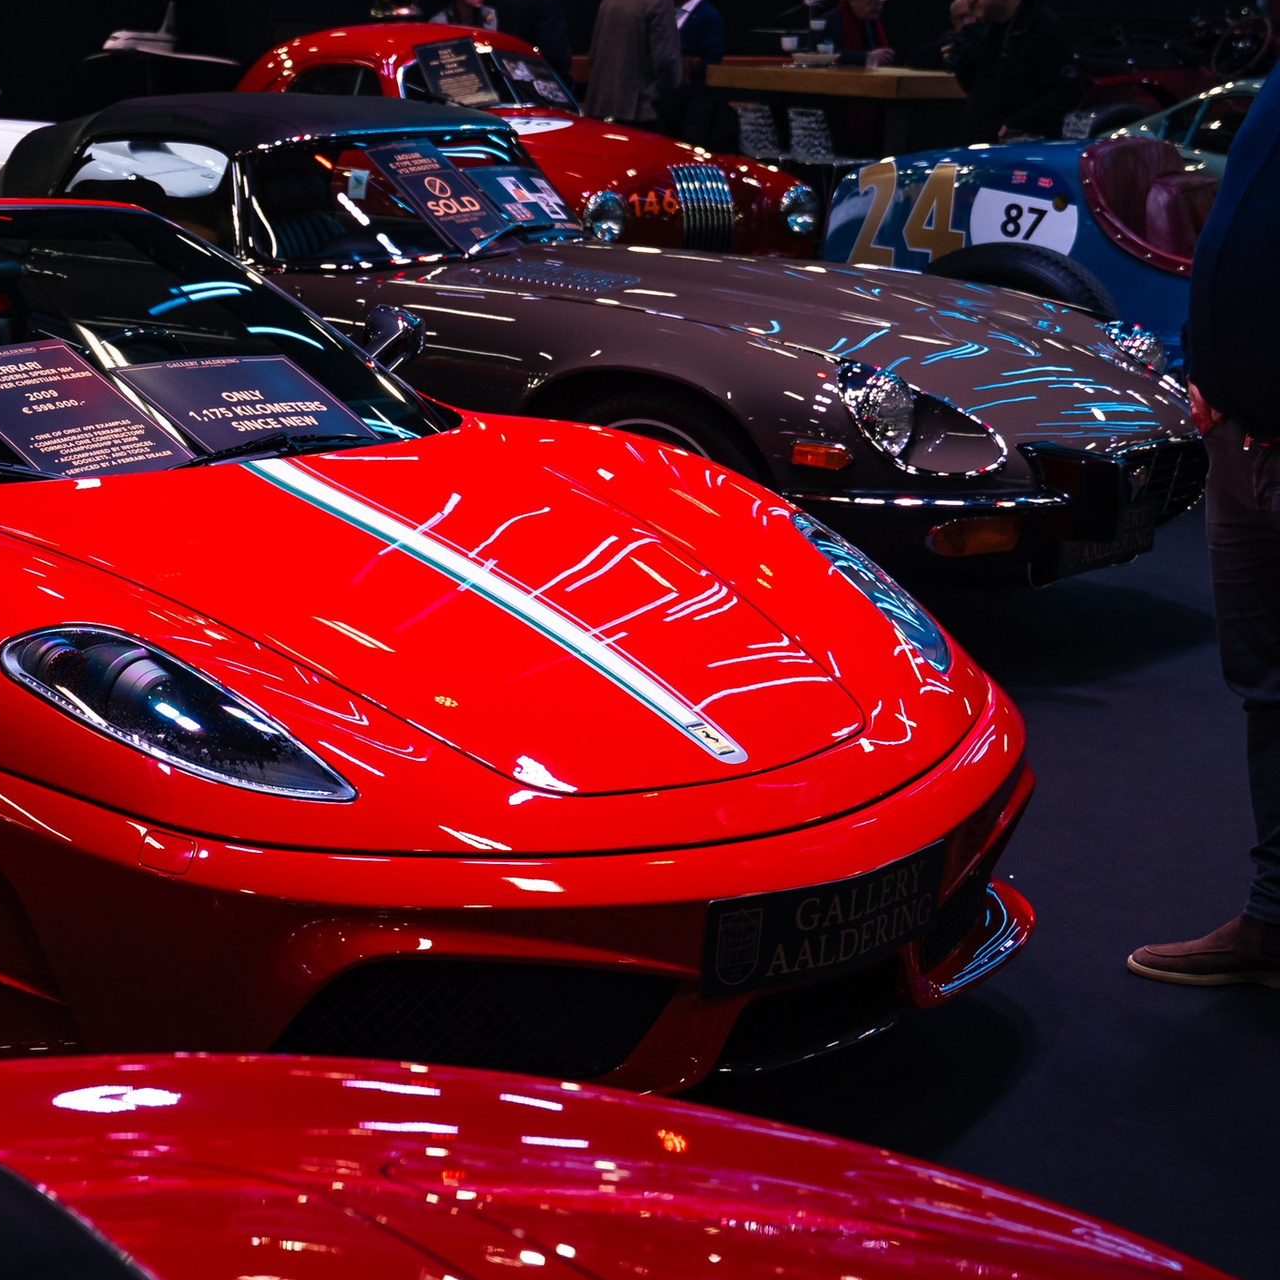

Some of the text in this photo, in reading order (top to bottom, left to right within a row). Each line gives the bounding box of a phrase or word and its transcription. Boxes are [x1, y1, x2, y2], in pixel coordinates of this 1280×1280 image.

[394, 152, 422, 162] JAGUAR
[427, 195, 480, 217] SOLD
[629, 188, 679, 217] 146
[847, 160, 967, 267] 24
[1000, 203, 1048, 241] 87
[166, 360, 198, 369] GALLERY
[29, 368, 57, 379] SPIDER
[62, 370, 92, 381] ALBERS
[24, 389, 59, 402] 2009
[221, 389, 264, 403] ONLY
[21, 406, 33, 415] €
[189, 401, 328, 422] 1,175 KILOMETERS
[35, 433, 51, 441] ONE
[63, 427, 82, 435] ONLY
[96, 419, 131, 429] EXAMPLES
[231, 415, 319, 433] SINCE NEW
[34, 433, 94, 448] COMMEMORATES
[40, 441, 74, 453] FORMULA
[74, 439, 91, 447] ONE
[60, 441, 112, 455] CHAMPIONSHIP
[112, 450, 128, 459] AND
[128, 447, 151, 455] TOOLS
[65, 464, 100, 476] SERVICED
[117, 454, 146, 465] FERRARI
[146, 449, 173, 460] DEALER
[795, 859, 926, 932] GALLERY
[764, 893, 932, 978] AALDERING
